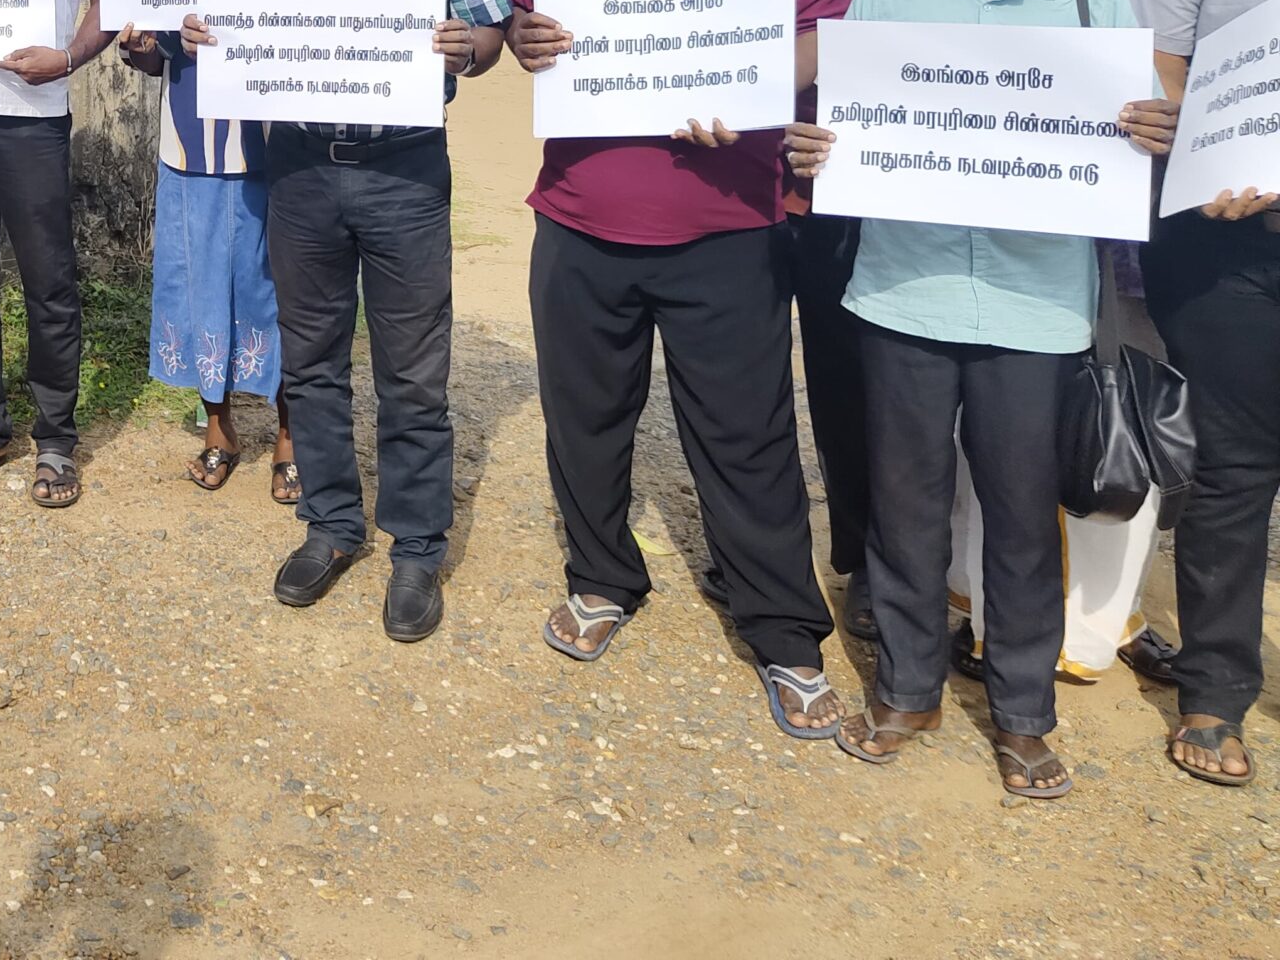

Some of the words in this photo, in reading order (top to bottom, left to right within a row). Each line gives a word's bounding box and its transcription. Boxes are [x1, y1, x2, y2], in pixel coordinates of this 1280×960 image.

[258, 11, 336, 28] சின்னங்களை
[614, 34, 682, 56] மரபுரிமை
[686, 23, 784, 49] சின்னங்களை
[225, 44, 275, 65] தமிழரின்
[279, 45, 331, 63] மரபுரிமை
[334, 45, 413, 63] சின்னங்களை
[246, 77, 303, 95] பாதுகாக்க
[307, 79, 370, 95] நடவடிக்கை
[373, 81, 391, 98] எடு
[573, 73, 648, 96] பாதுகாக்க
[652, 69, 732, 93] நடவடிக்கை
[736, 65, 758, 85] எடு
[901, 63, 989, 86] இலங்கை
[996, 67, 1054, 91] அரசே
[829, 101, 908, 130] தமிழரின்
[913, 108, 997, 131] மரபுரிமை
[860, 151, 951, 172] பாதுகாக்க
[958, 157, 1062, 180] நடவடிக்கை
[1070, 163, 1099, 186] எடு
